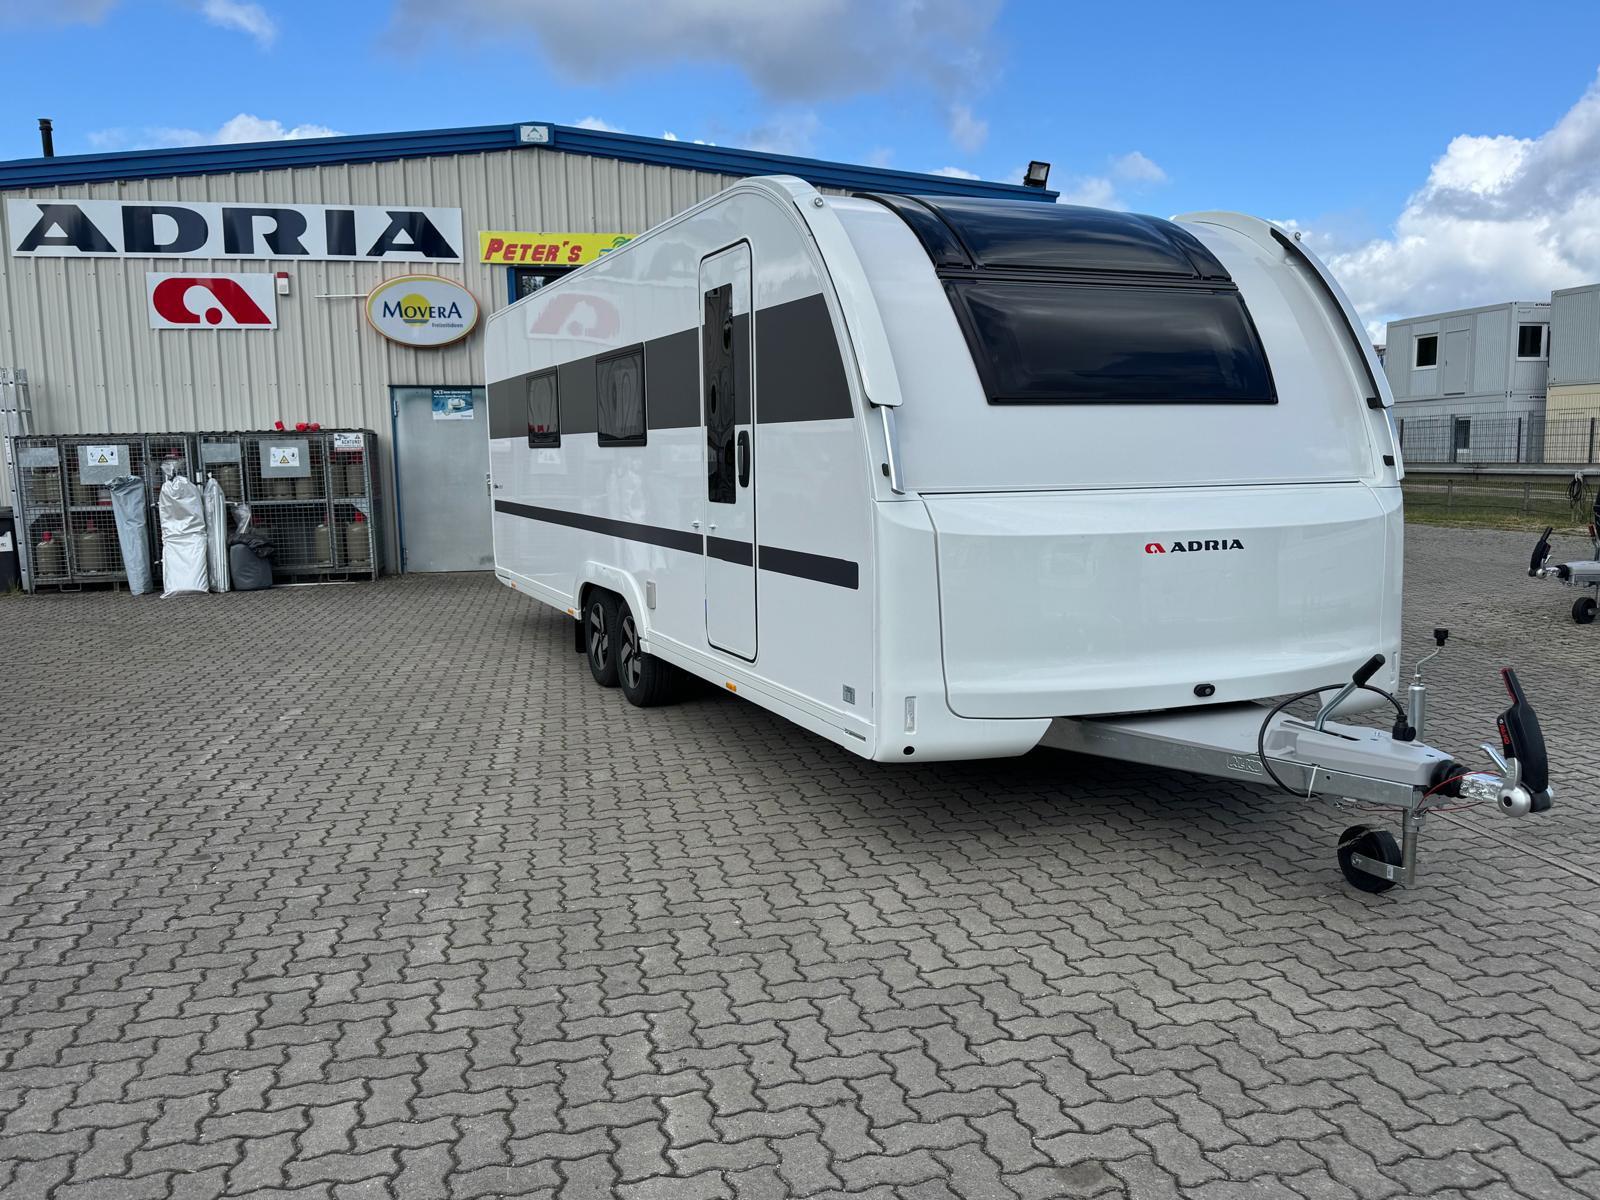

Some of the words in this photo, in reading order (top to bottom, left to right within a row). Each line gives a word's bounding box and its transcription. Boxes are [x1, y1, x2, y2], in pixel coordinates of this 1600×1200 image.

[16, 203, 460, 258] ADRIA
[484, 238, 583, 262] PETER'S
[1170, 539, 1245, 553] ADRIA
